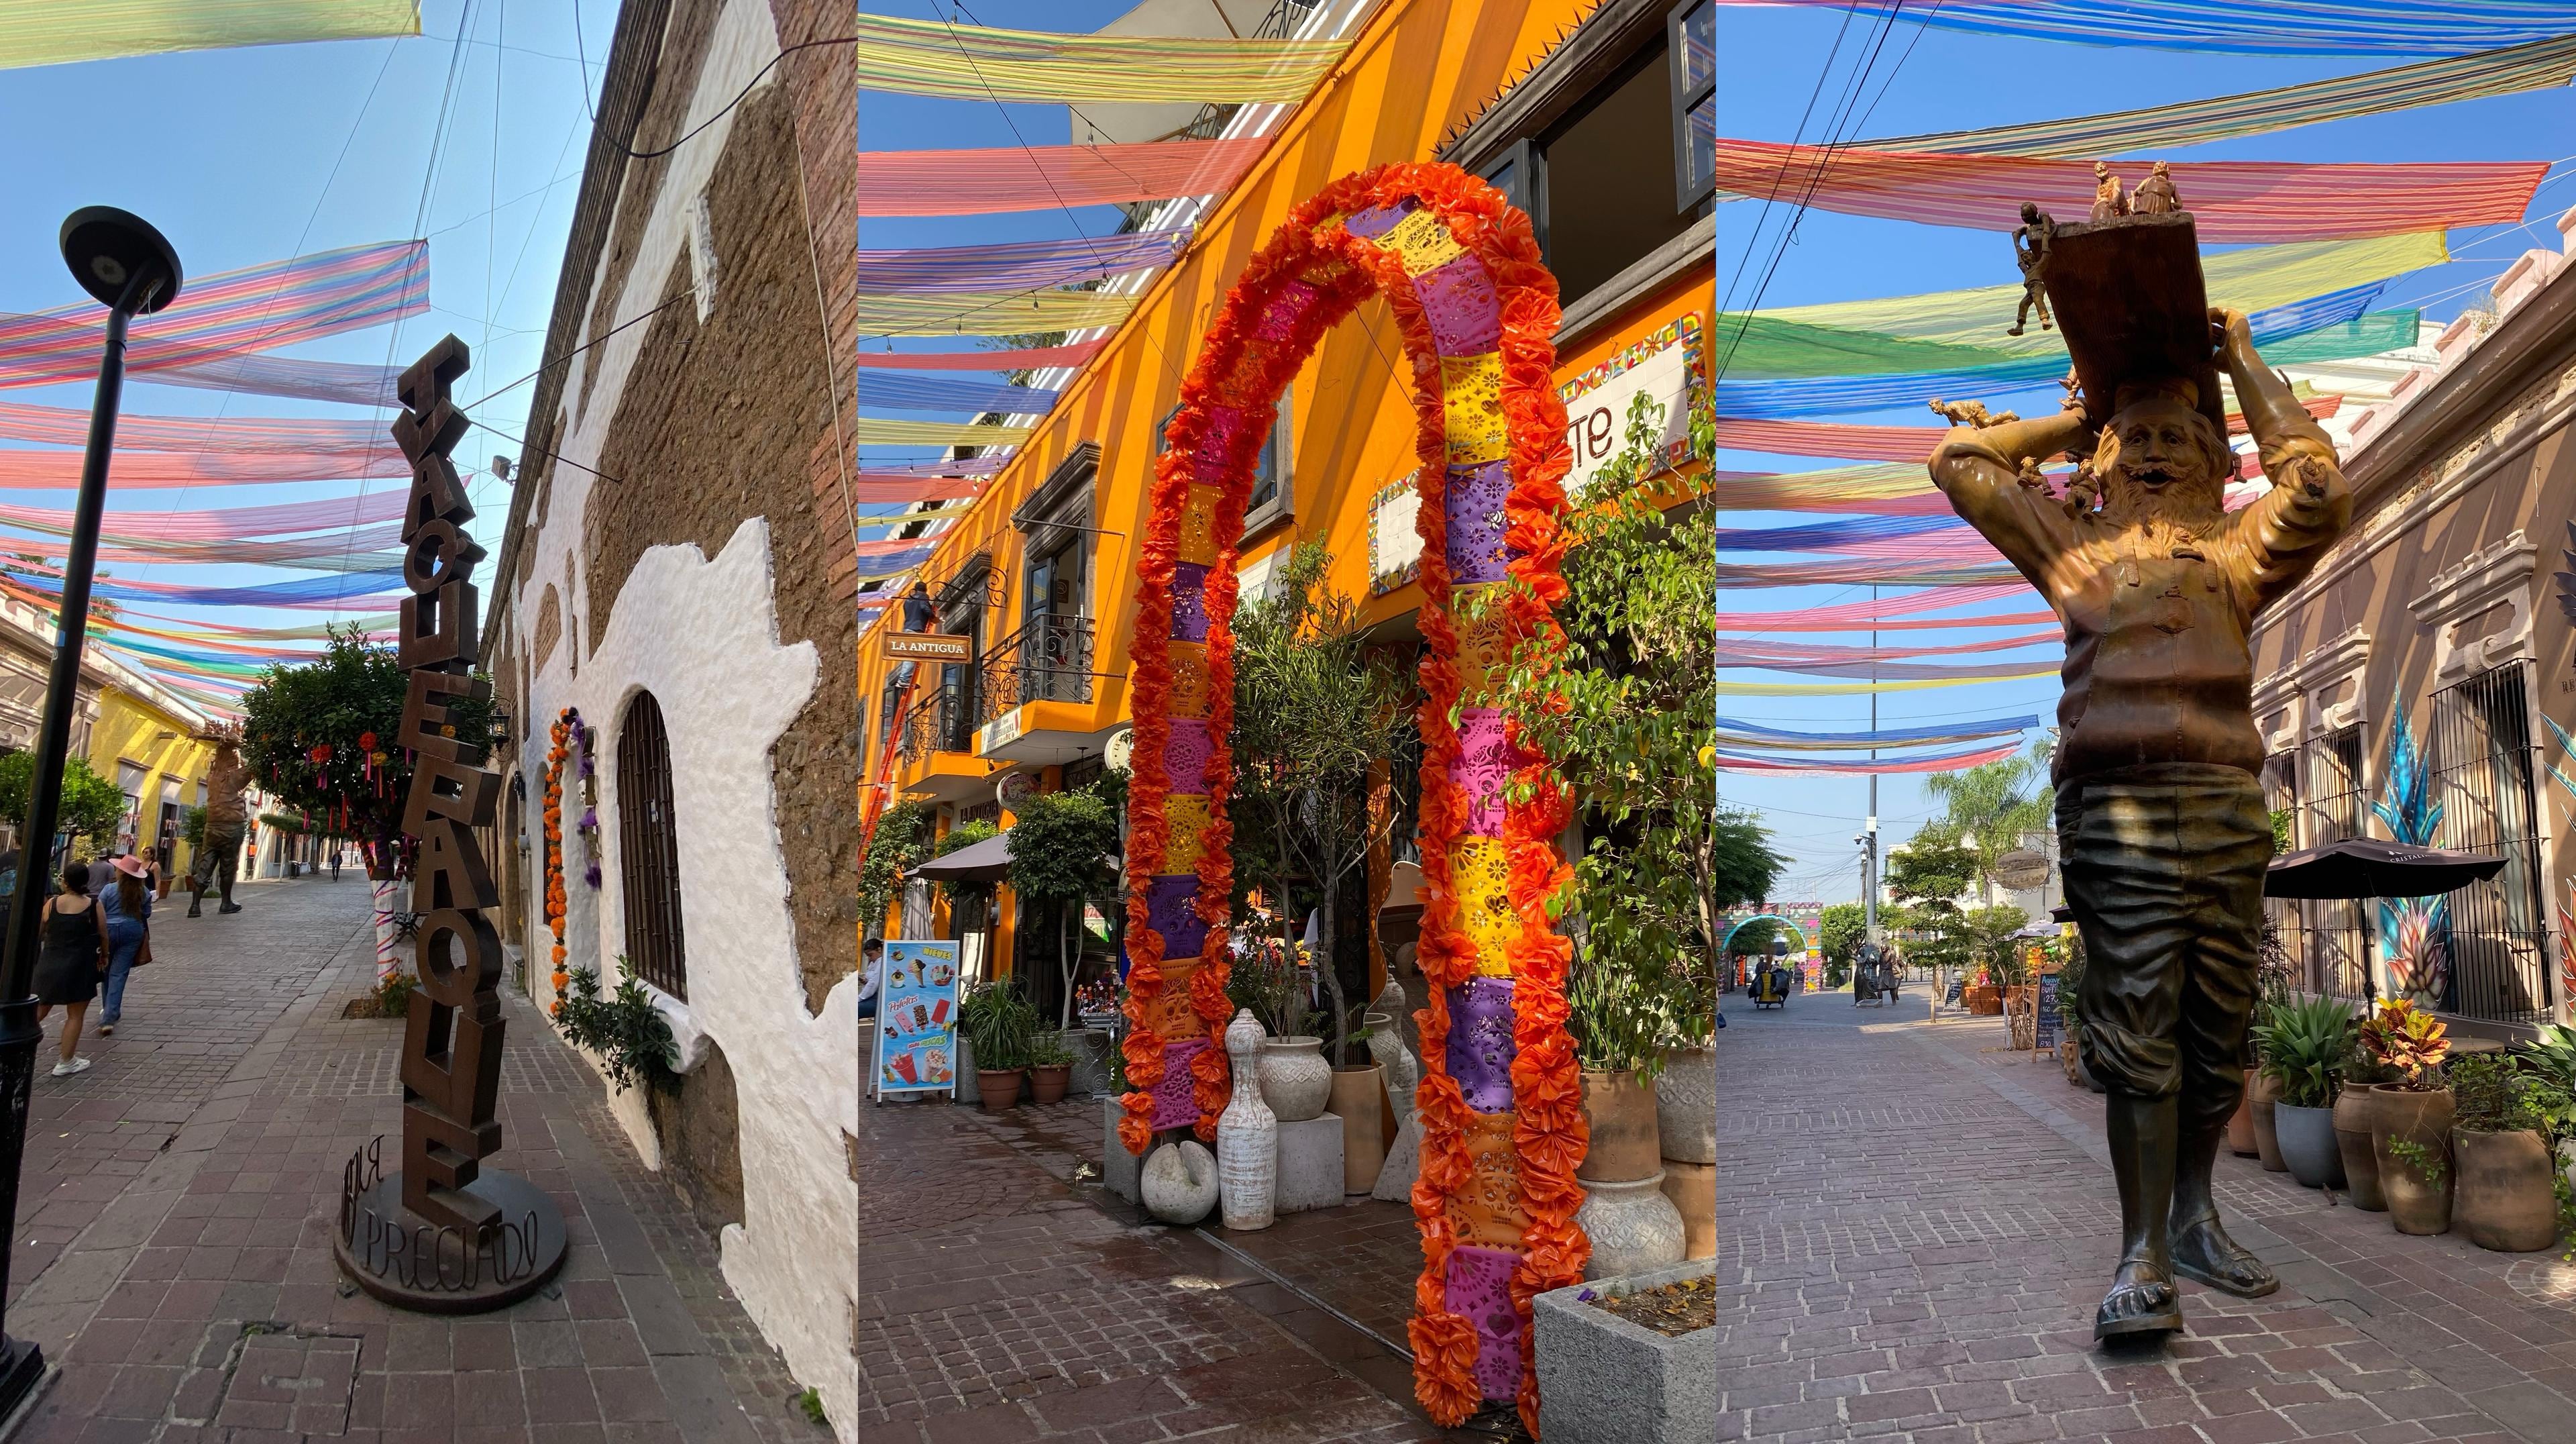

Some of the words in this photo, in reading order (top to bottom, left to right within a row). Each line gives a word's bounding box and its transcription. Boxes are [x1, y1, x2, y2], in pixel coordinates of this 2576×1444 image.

[891, 641, 907, 651] LA
[909, 642, 965, 654] ANTIGUA
[922, 947, 953, 962] NIEVES
[888, 994, 918, 1013] Paletas
[362, 1207, 539, 1292] PRECIADO
